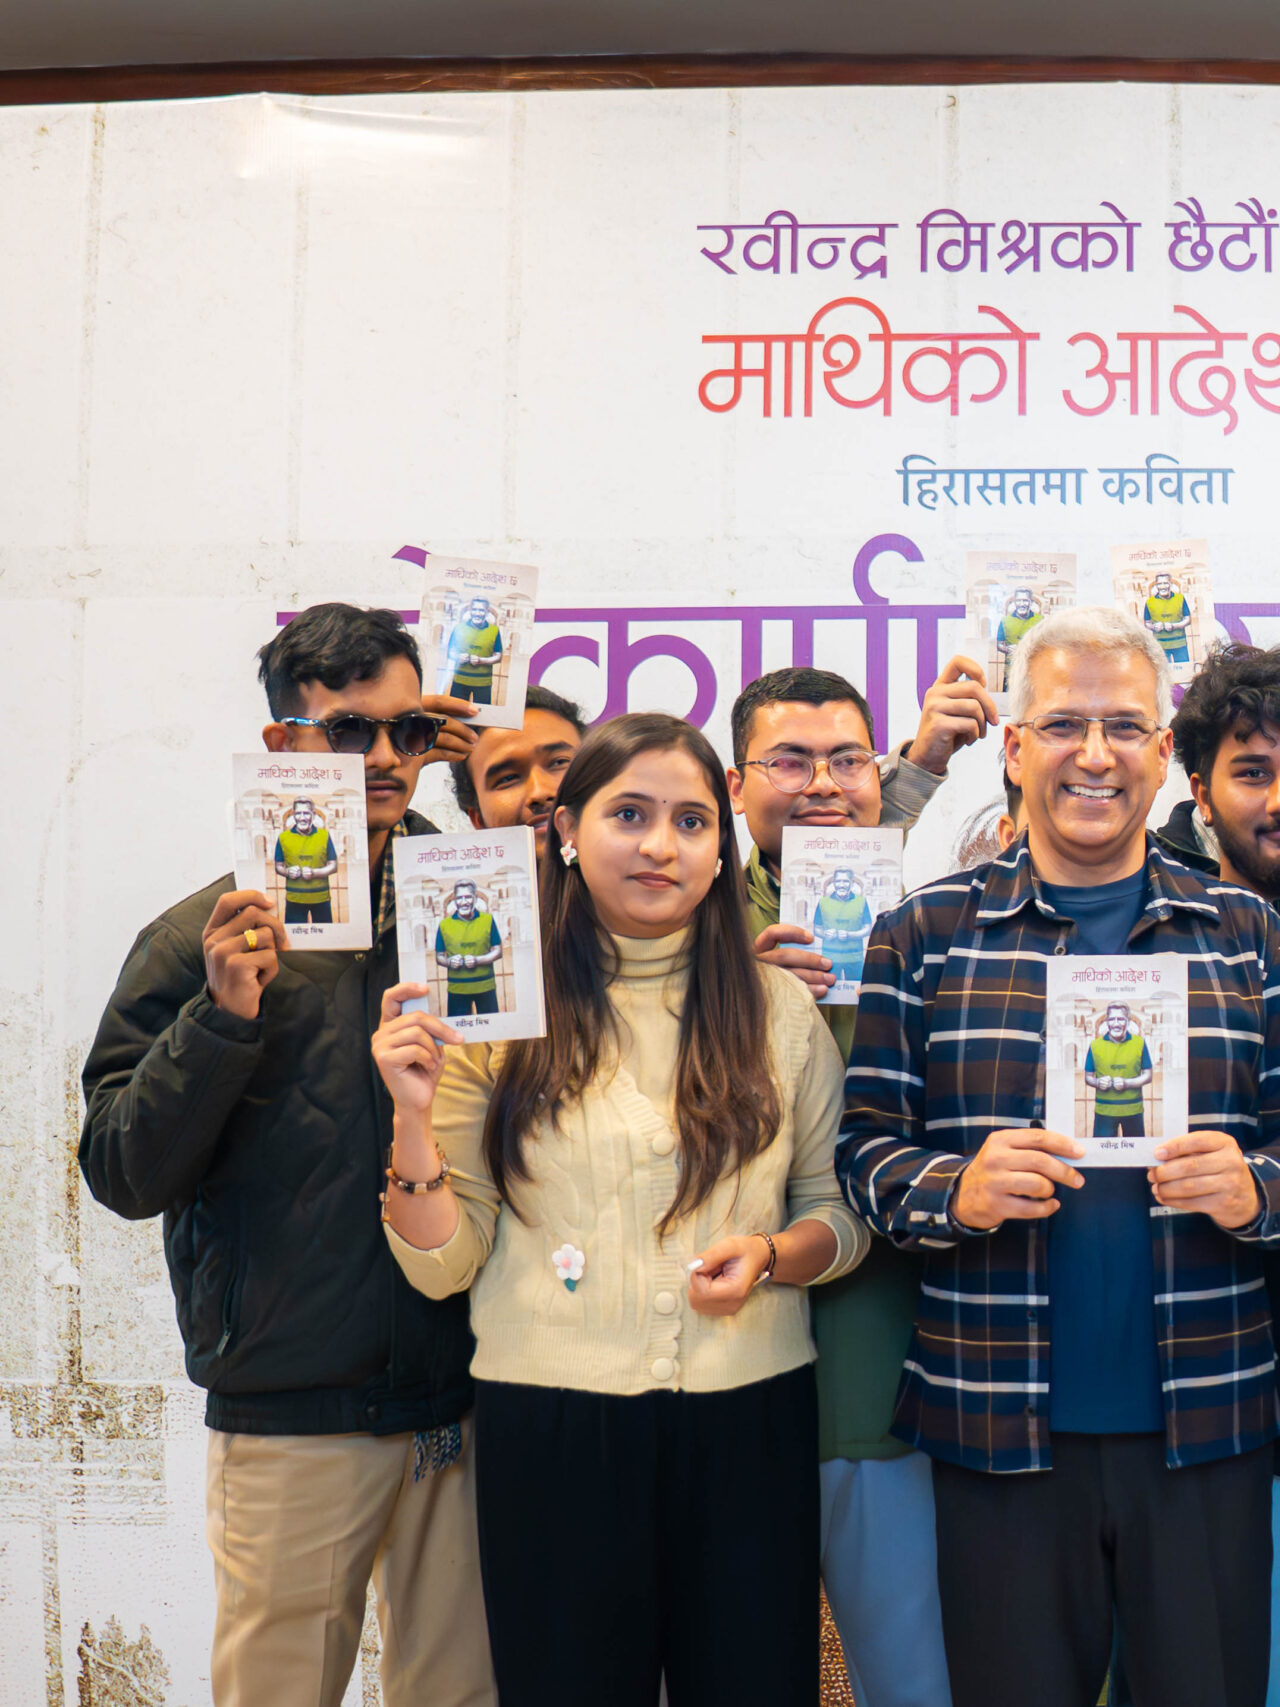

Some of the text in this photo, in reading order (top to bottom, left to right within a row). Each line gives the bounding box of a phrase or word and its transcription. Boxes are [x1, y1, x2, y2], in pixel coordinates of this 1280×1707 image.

[697, 210, 898, 280] रवीन्द्र
[917, 200, 1141, 275] मिश्रको
[1166, 197, 1279, 273] छैटौं
[698, 296, 1040, 419] माथिको
[896, 453, 1235, 511] हिरासतमा कविता
